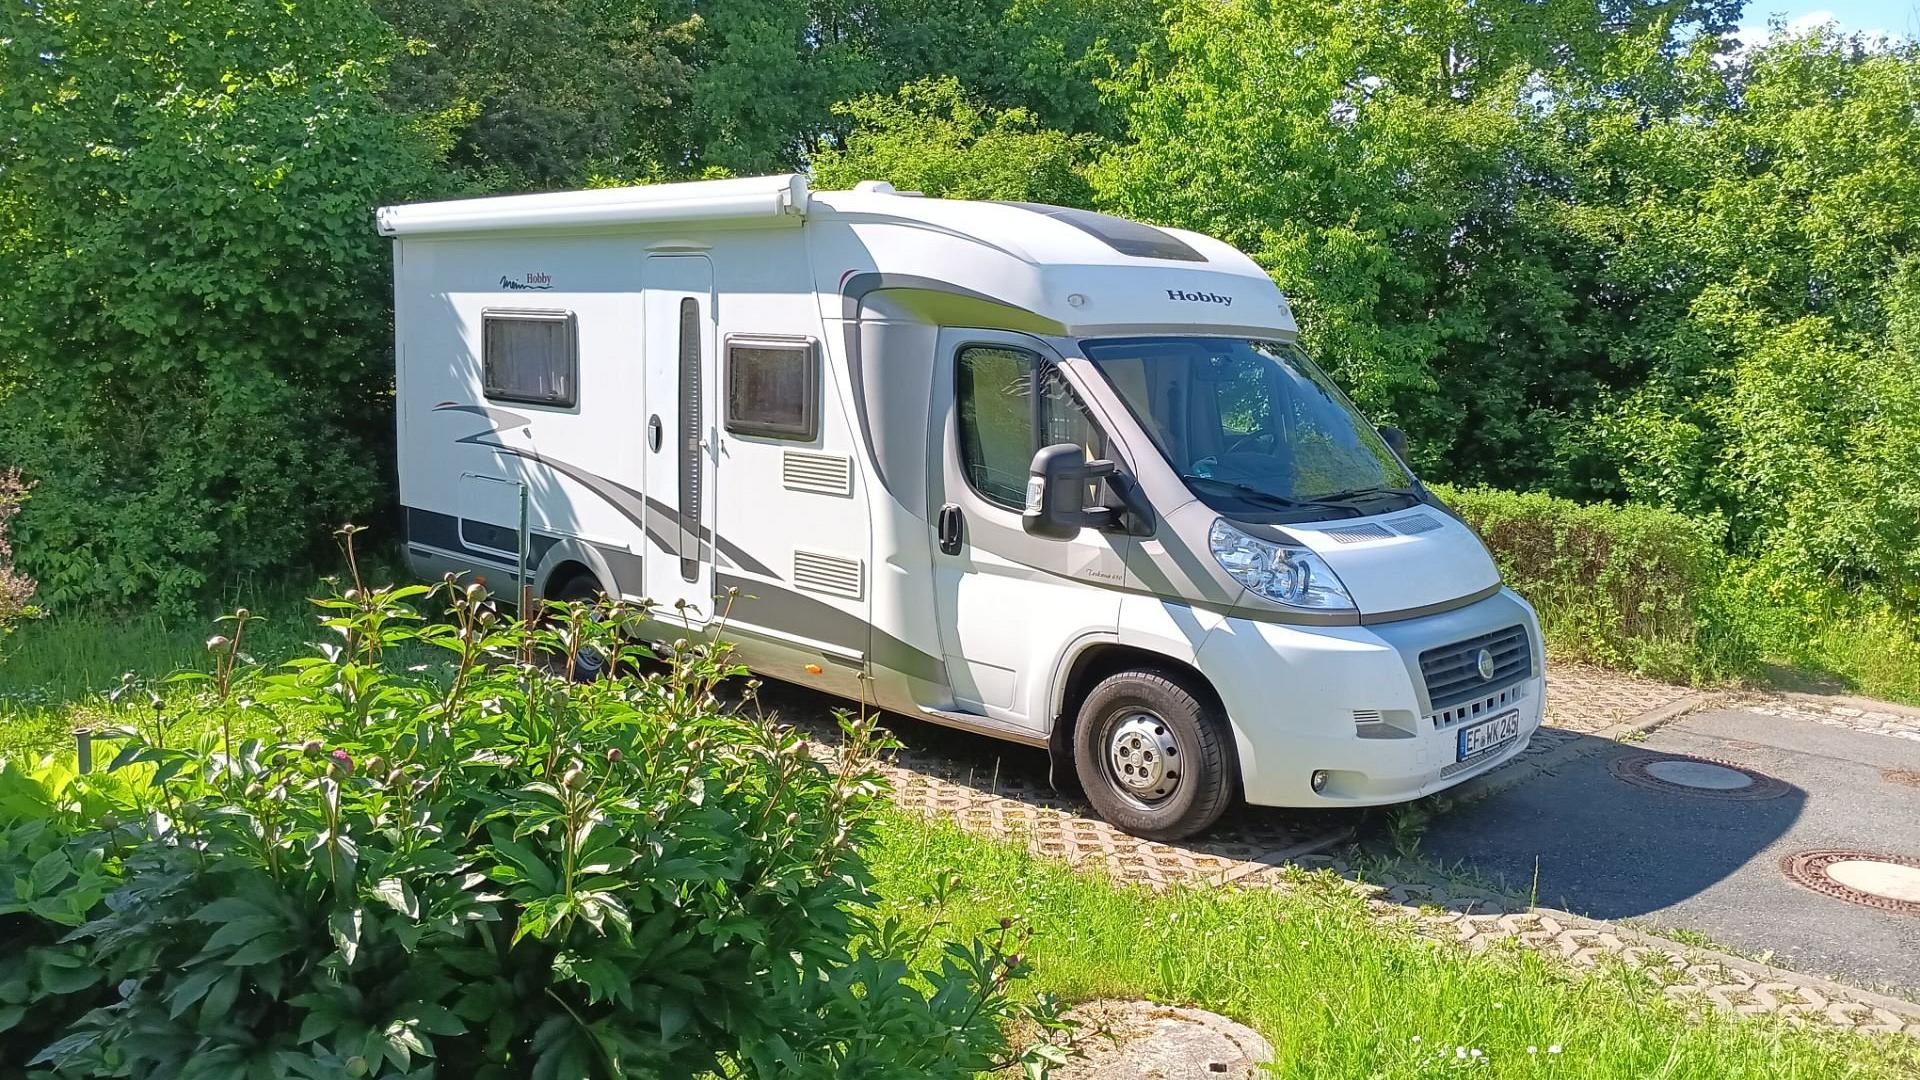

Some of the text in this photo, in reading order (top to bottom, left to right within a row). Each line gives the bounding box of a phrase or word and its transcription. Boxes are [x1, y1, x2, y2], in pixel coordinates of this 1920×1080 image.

[527, 272, 552, 286] Hobby
[1166, 289, 1232, 307] Hobby
[1500, 714, 1517, 739] 245
